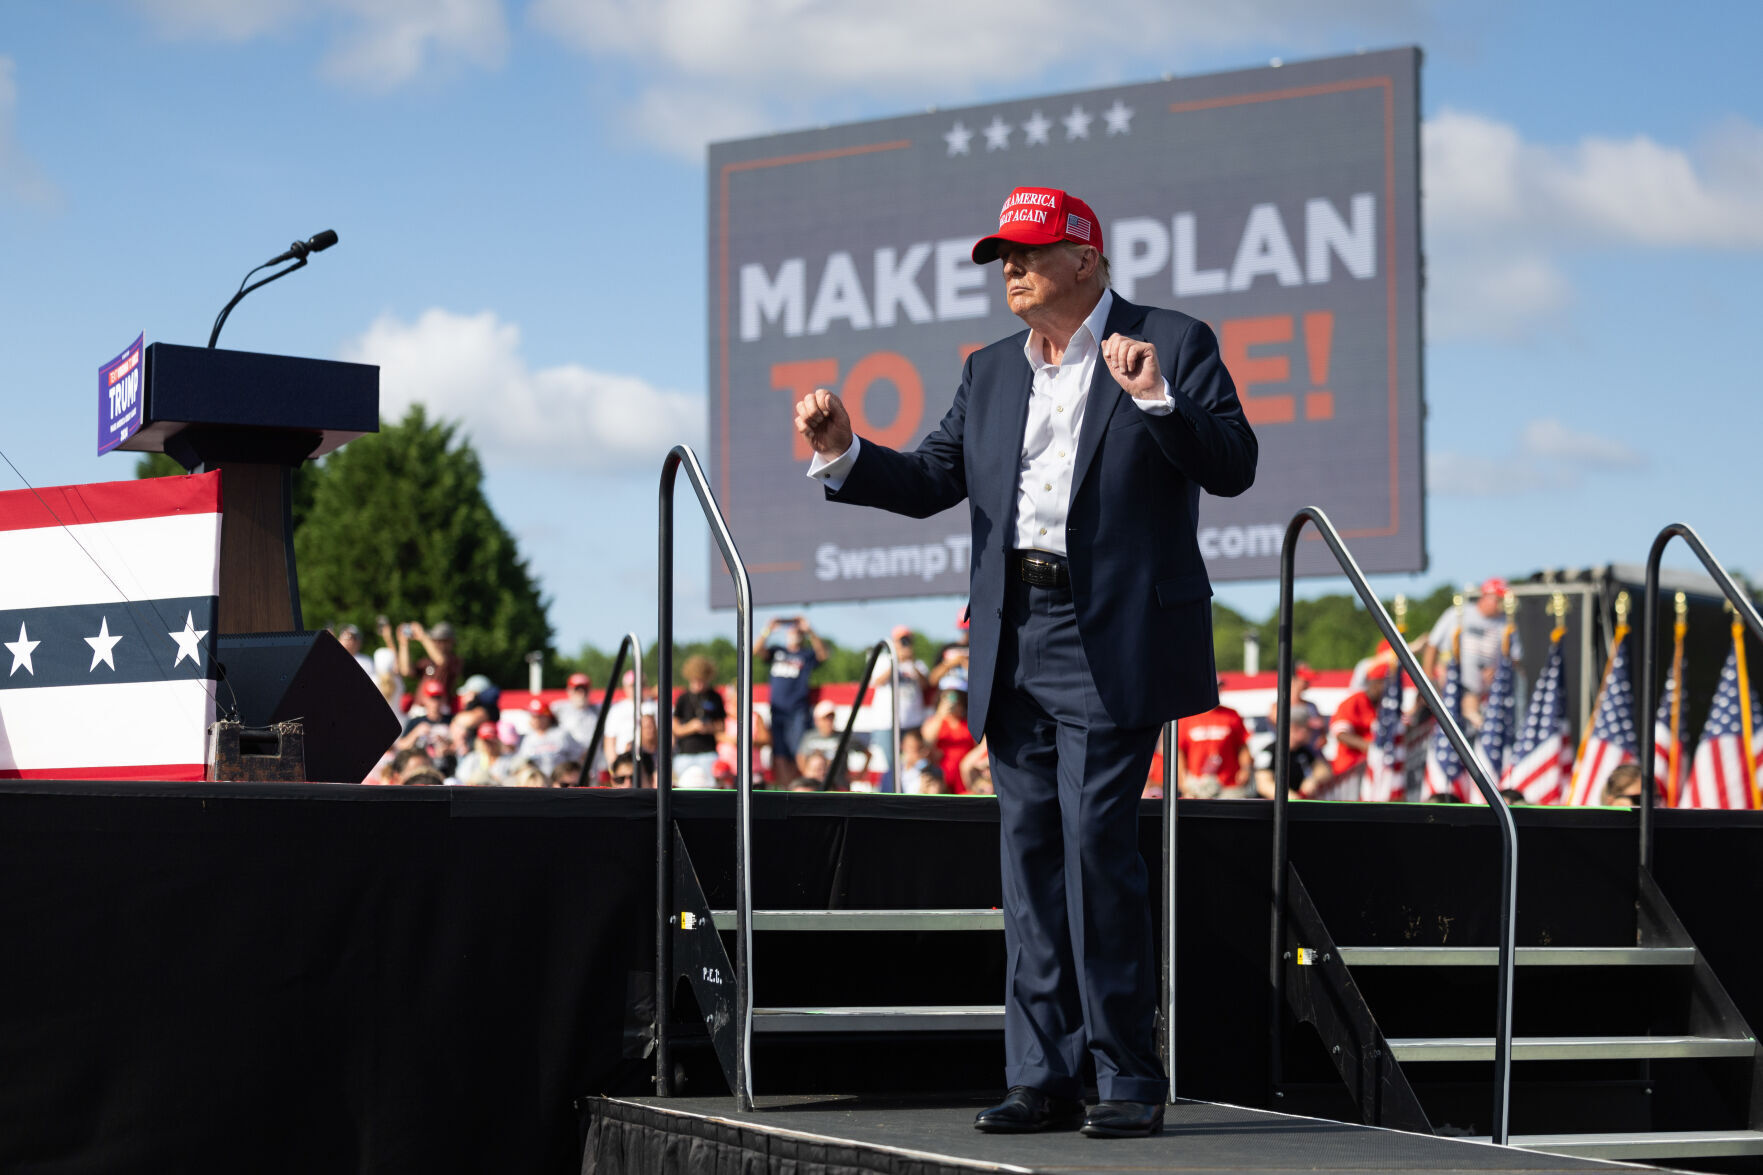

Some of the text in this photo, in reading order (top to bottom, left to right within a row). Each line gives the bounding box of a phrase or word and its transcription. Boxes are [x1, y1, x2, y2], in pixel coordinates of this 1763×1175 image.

[1011, 193, 1055, 208] AMERICA
[1013, 209, 1047, 224] AGAIN
[740, 193, 1376, 341] MAKE PLAN
[109, 368, 138, 420] TRUMP
[771, 351, 924, 461] TO
[815, 523, 1287, 582] SwampT com
